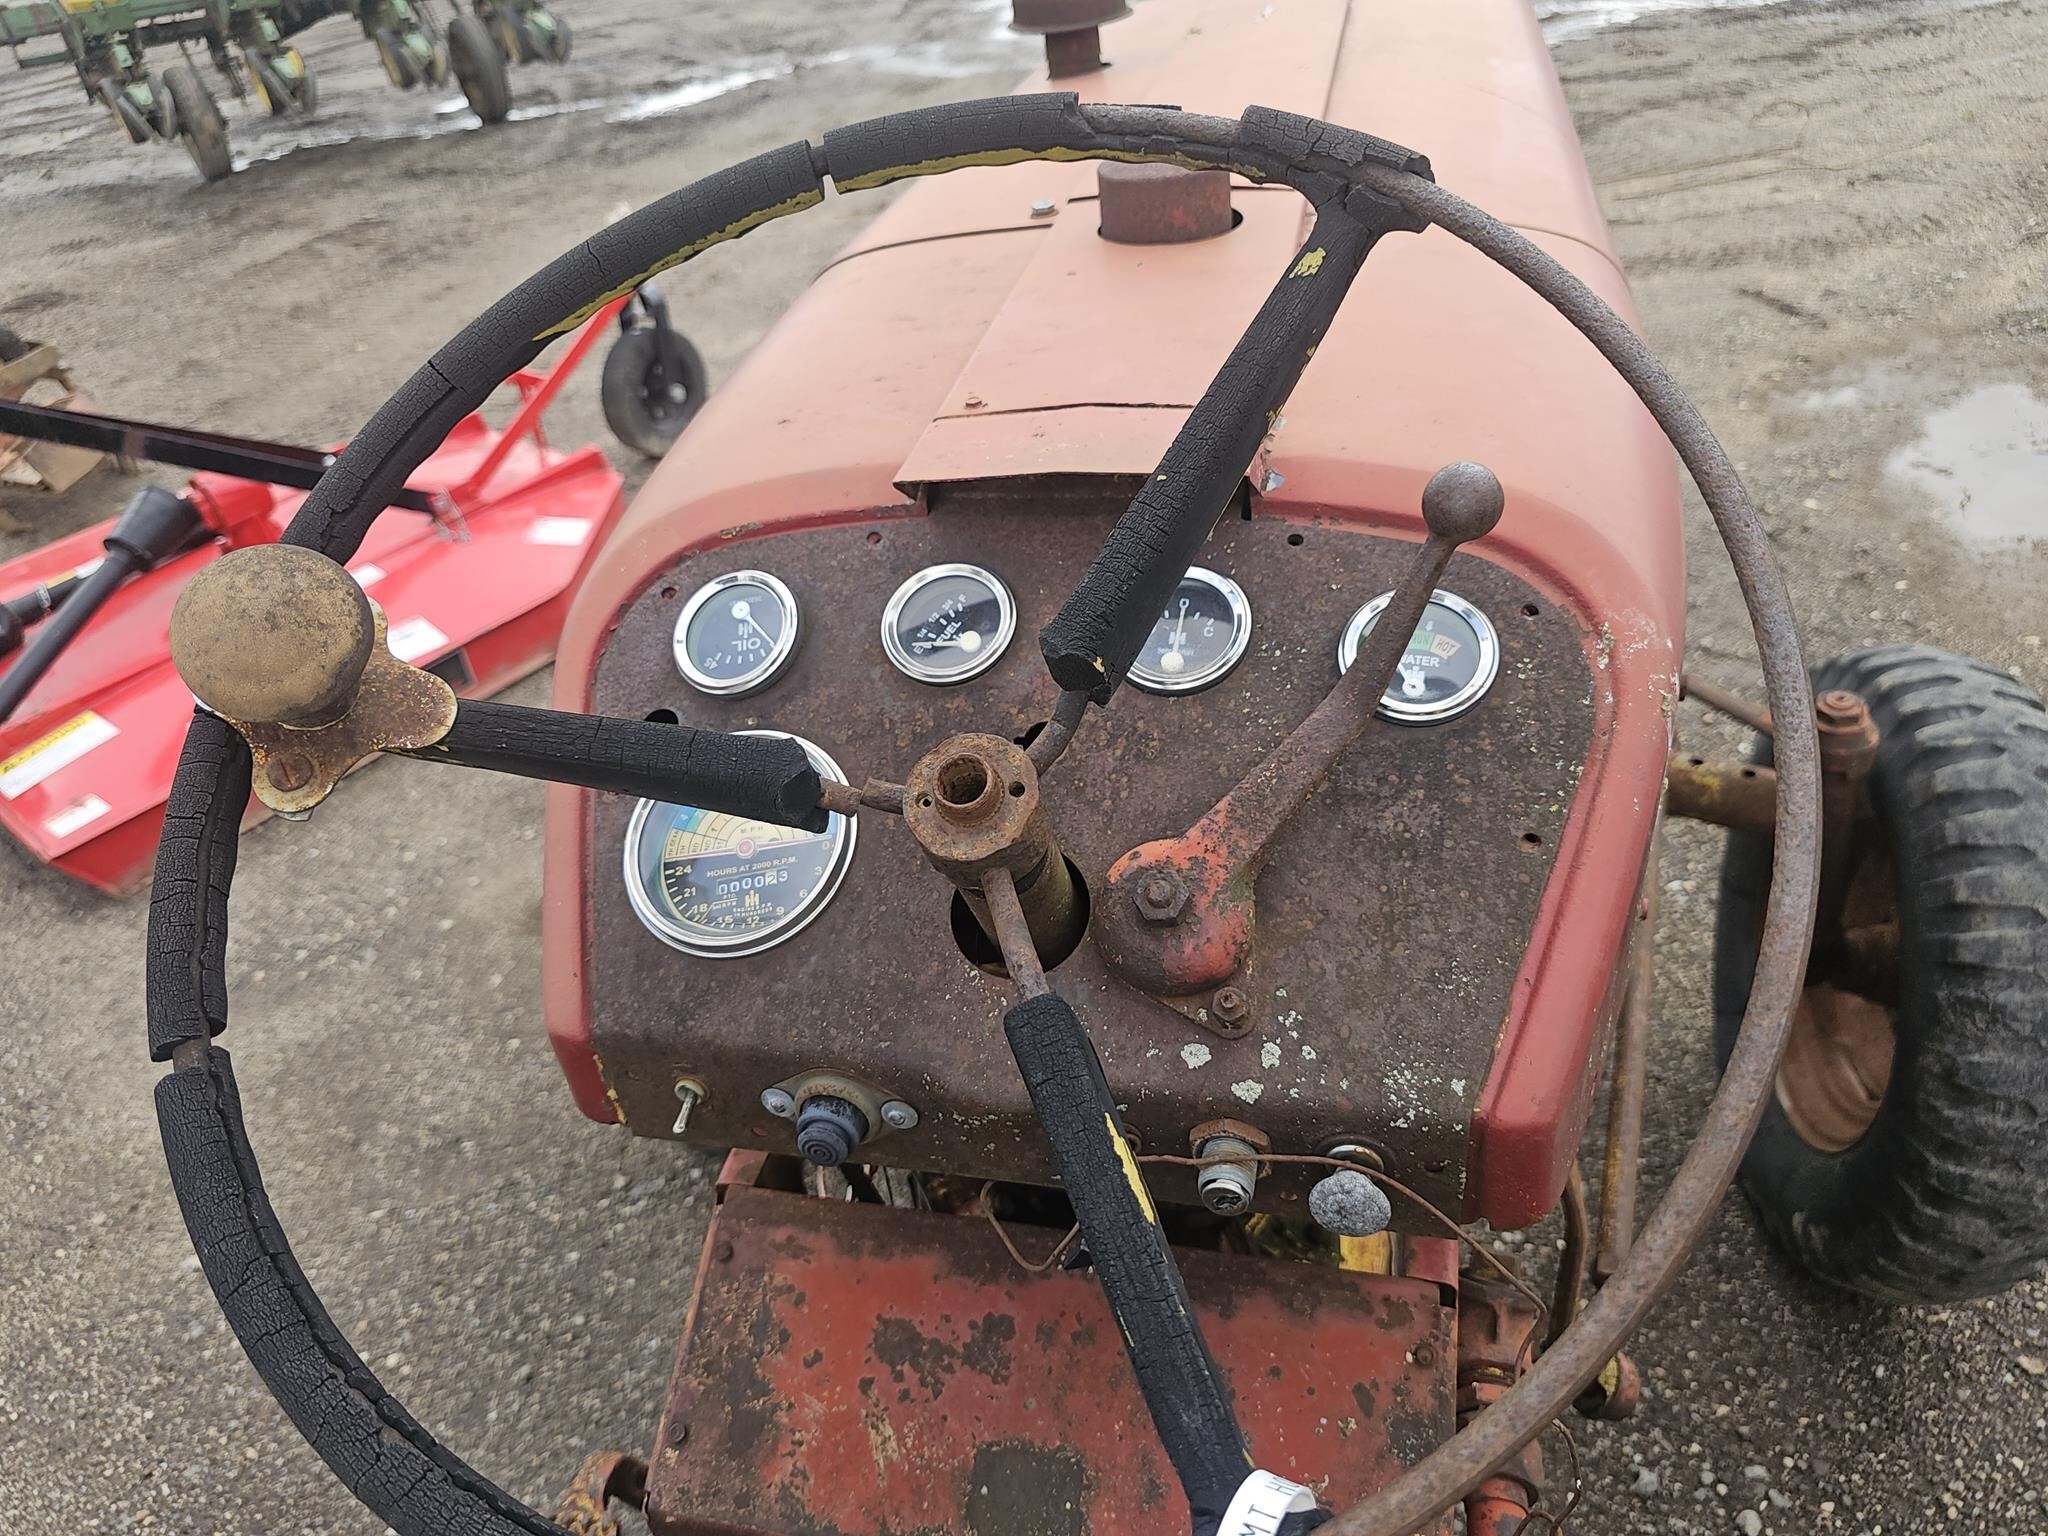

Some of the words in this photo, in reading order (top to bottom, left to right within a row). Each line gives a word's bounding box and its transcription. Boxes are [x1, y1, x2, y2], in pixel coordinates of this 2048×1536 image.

[928, 612, 940, 623] 1/2
[1203, 627, 1214, 637] C
[731, 637, 761, 652] OIL
[1435, 638, 1456, 654] HOT
[822, 841, 830, 850] 0
[675, 865, 692, 875] 24
[706, 866, 738, 878] HOURS
[739, 864, 751, 873] AT
[752, 860, 772, 870] 2000
[815, 866, 823, 875] 3
[683, 887, 697, 897] 21
[799, 888, 808, 898] 6
[691, 903, 708, 913] 18
[776, 906, 785, 916] 9
[746, 916, 760, 924] 12
